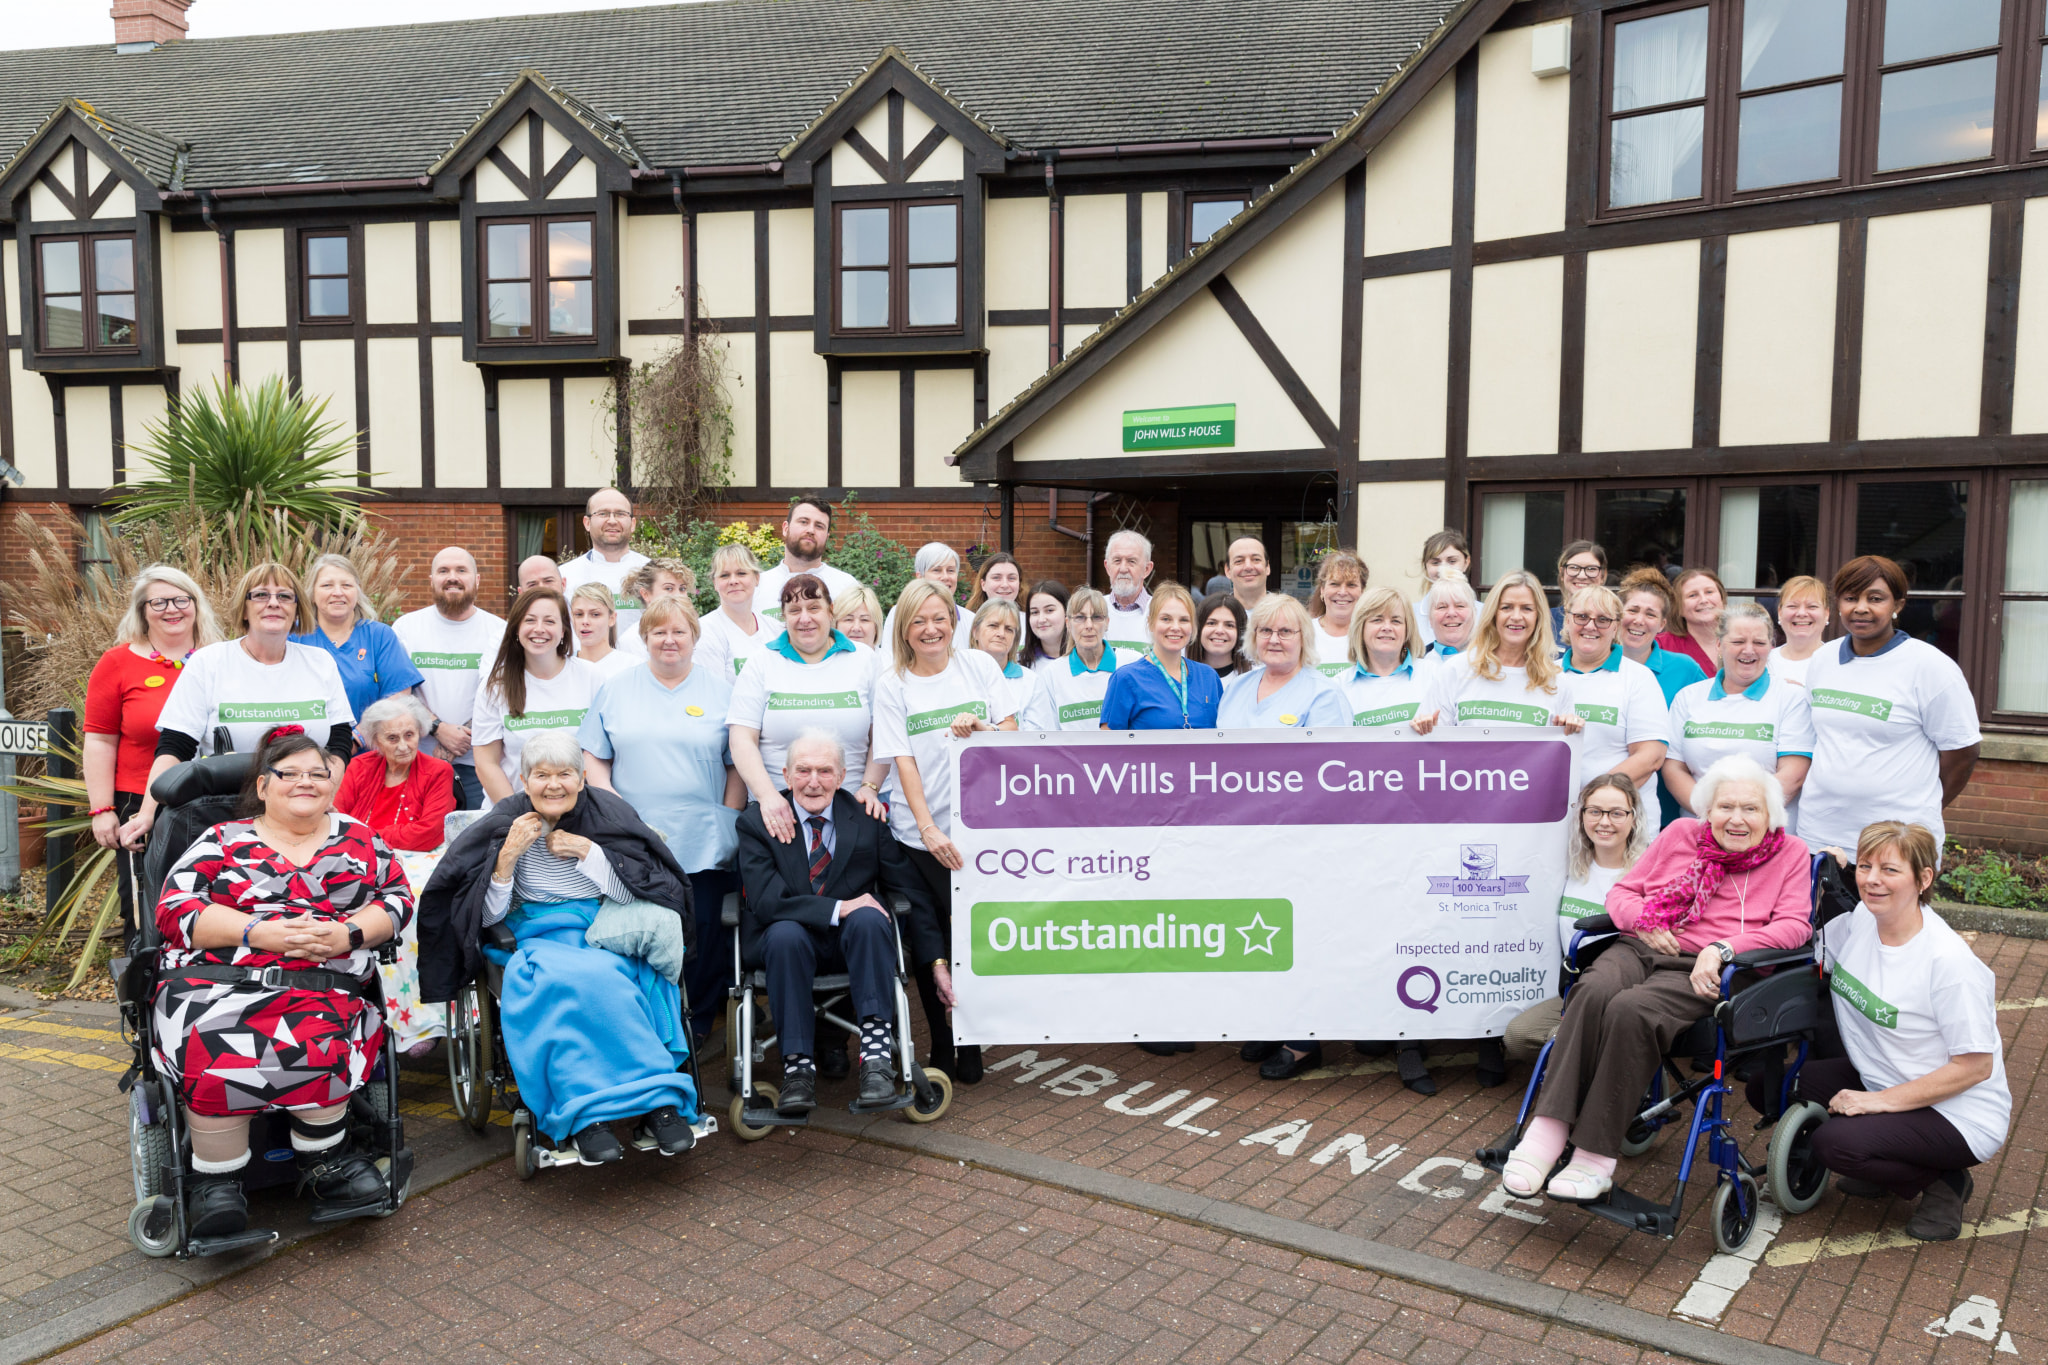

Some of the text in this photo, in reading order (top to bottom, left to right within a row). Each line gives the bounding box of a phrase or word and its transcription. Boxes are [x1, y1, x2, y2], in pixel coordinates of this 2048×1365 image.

[1132, 425, 1222, 443] JOHN WILLS HOUSE
[415, 656, 467, 668] Outstanding
[224, 707, 300, 719] Outstanding
[509, 715, 569, 728] Outstanding
[1460, 706, 1523, 721] Outstanding
[2, 725, 46, 751] OUSE
[995, 759, 1529, 806] John Wills House Care Home
[975, 848, 1151, 881] CQC rating
[1457, 883, 1502, 892] 100 Years
[1438, 901, 1518, 912] St Monica Trust
[988, 913, 1226, 958] Outstanding
[1396, 938, 1544, 958] Inspected and rated by
[1446, 985, 1545, 1005] Commission
[981, 1046, 1548, 1225] MBULANCE
